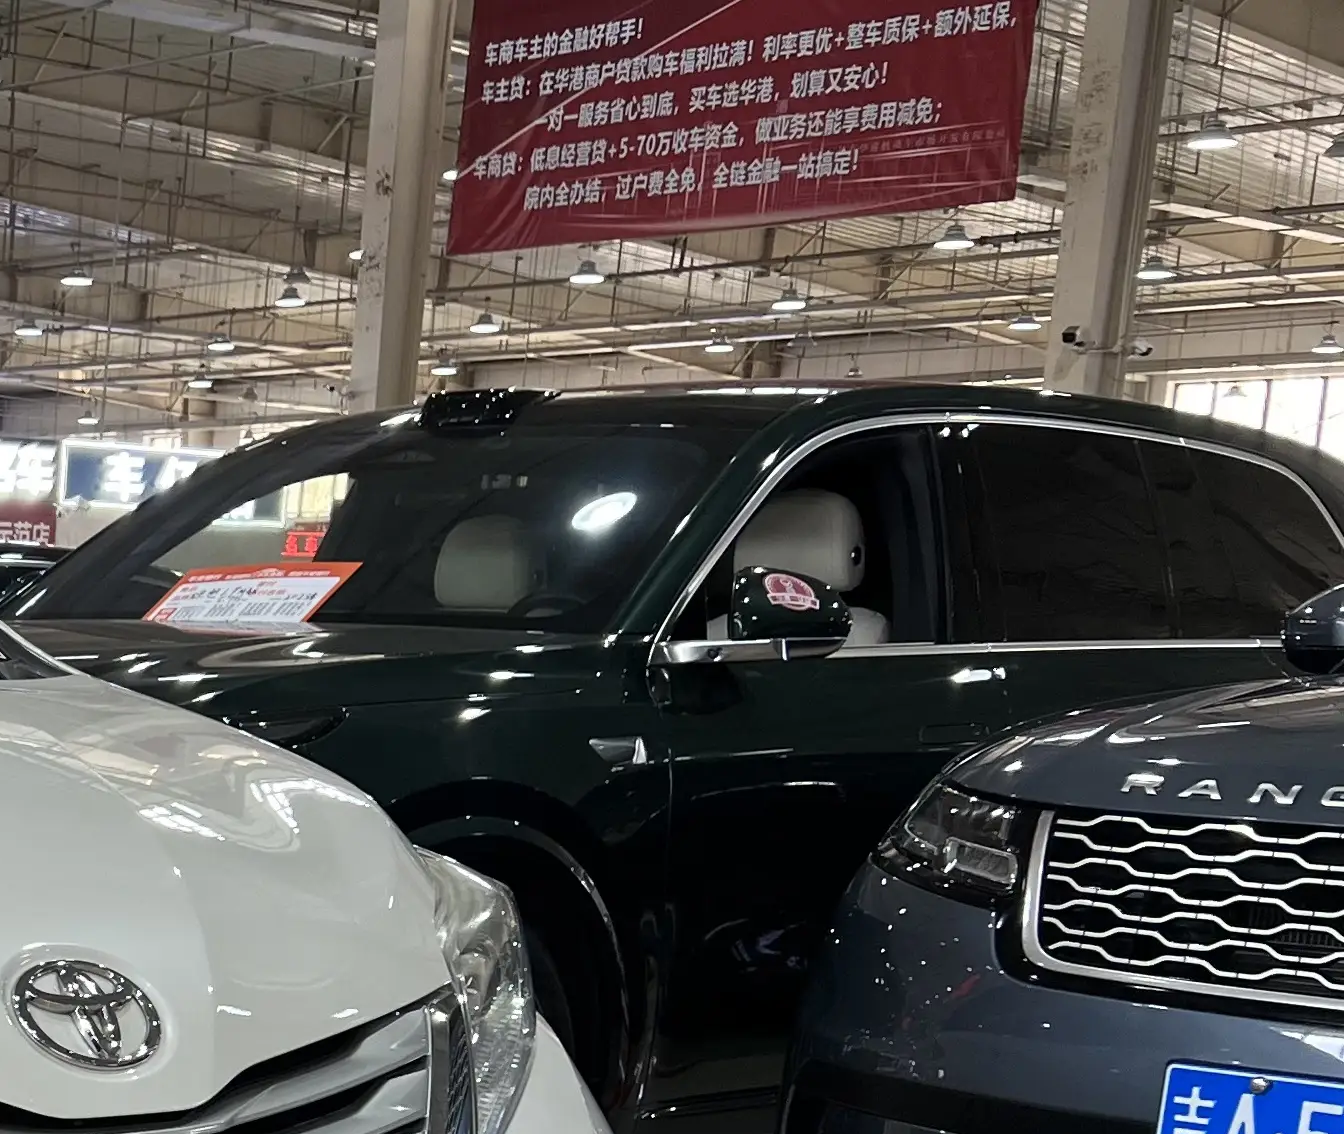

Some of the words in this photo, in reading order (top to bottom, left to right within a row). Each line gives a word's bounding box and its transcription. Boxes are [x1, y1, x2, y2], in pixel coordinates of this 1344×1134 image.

[484, 17, 644, 67] 车商车主的金融好帮手！
